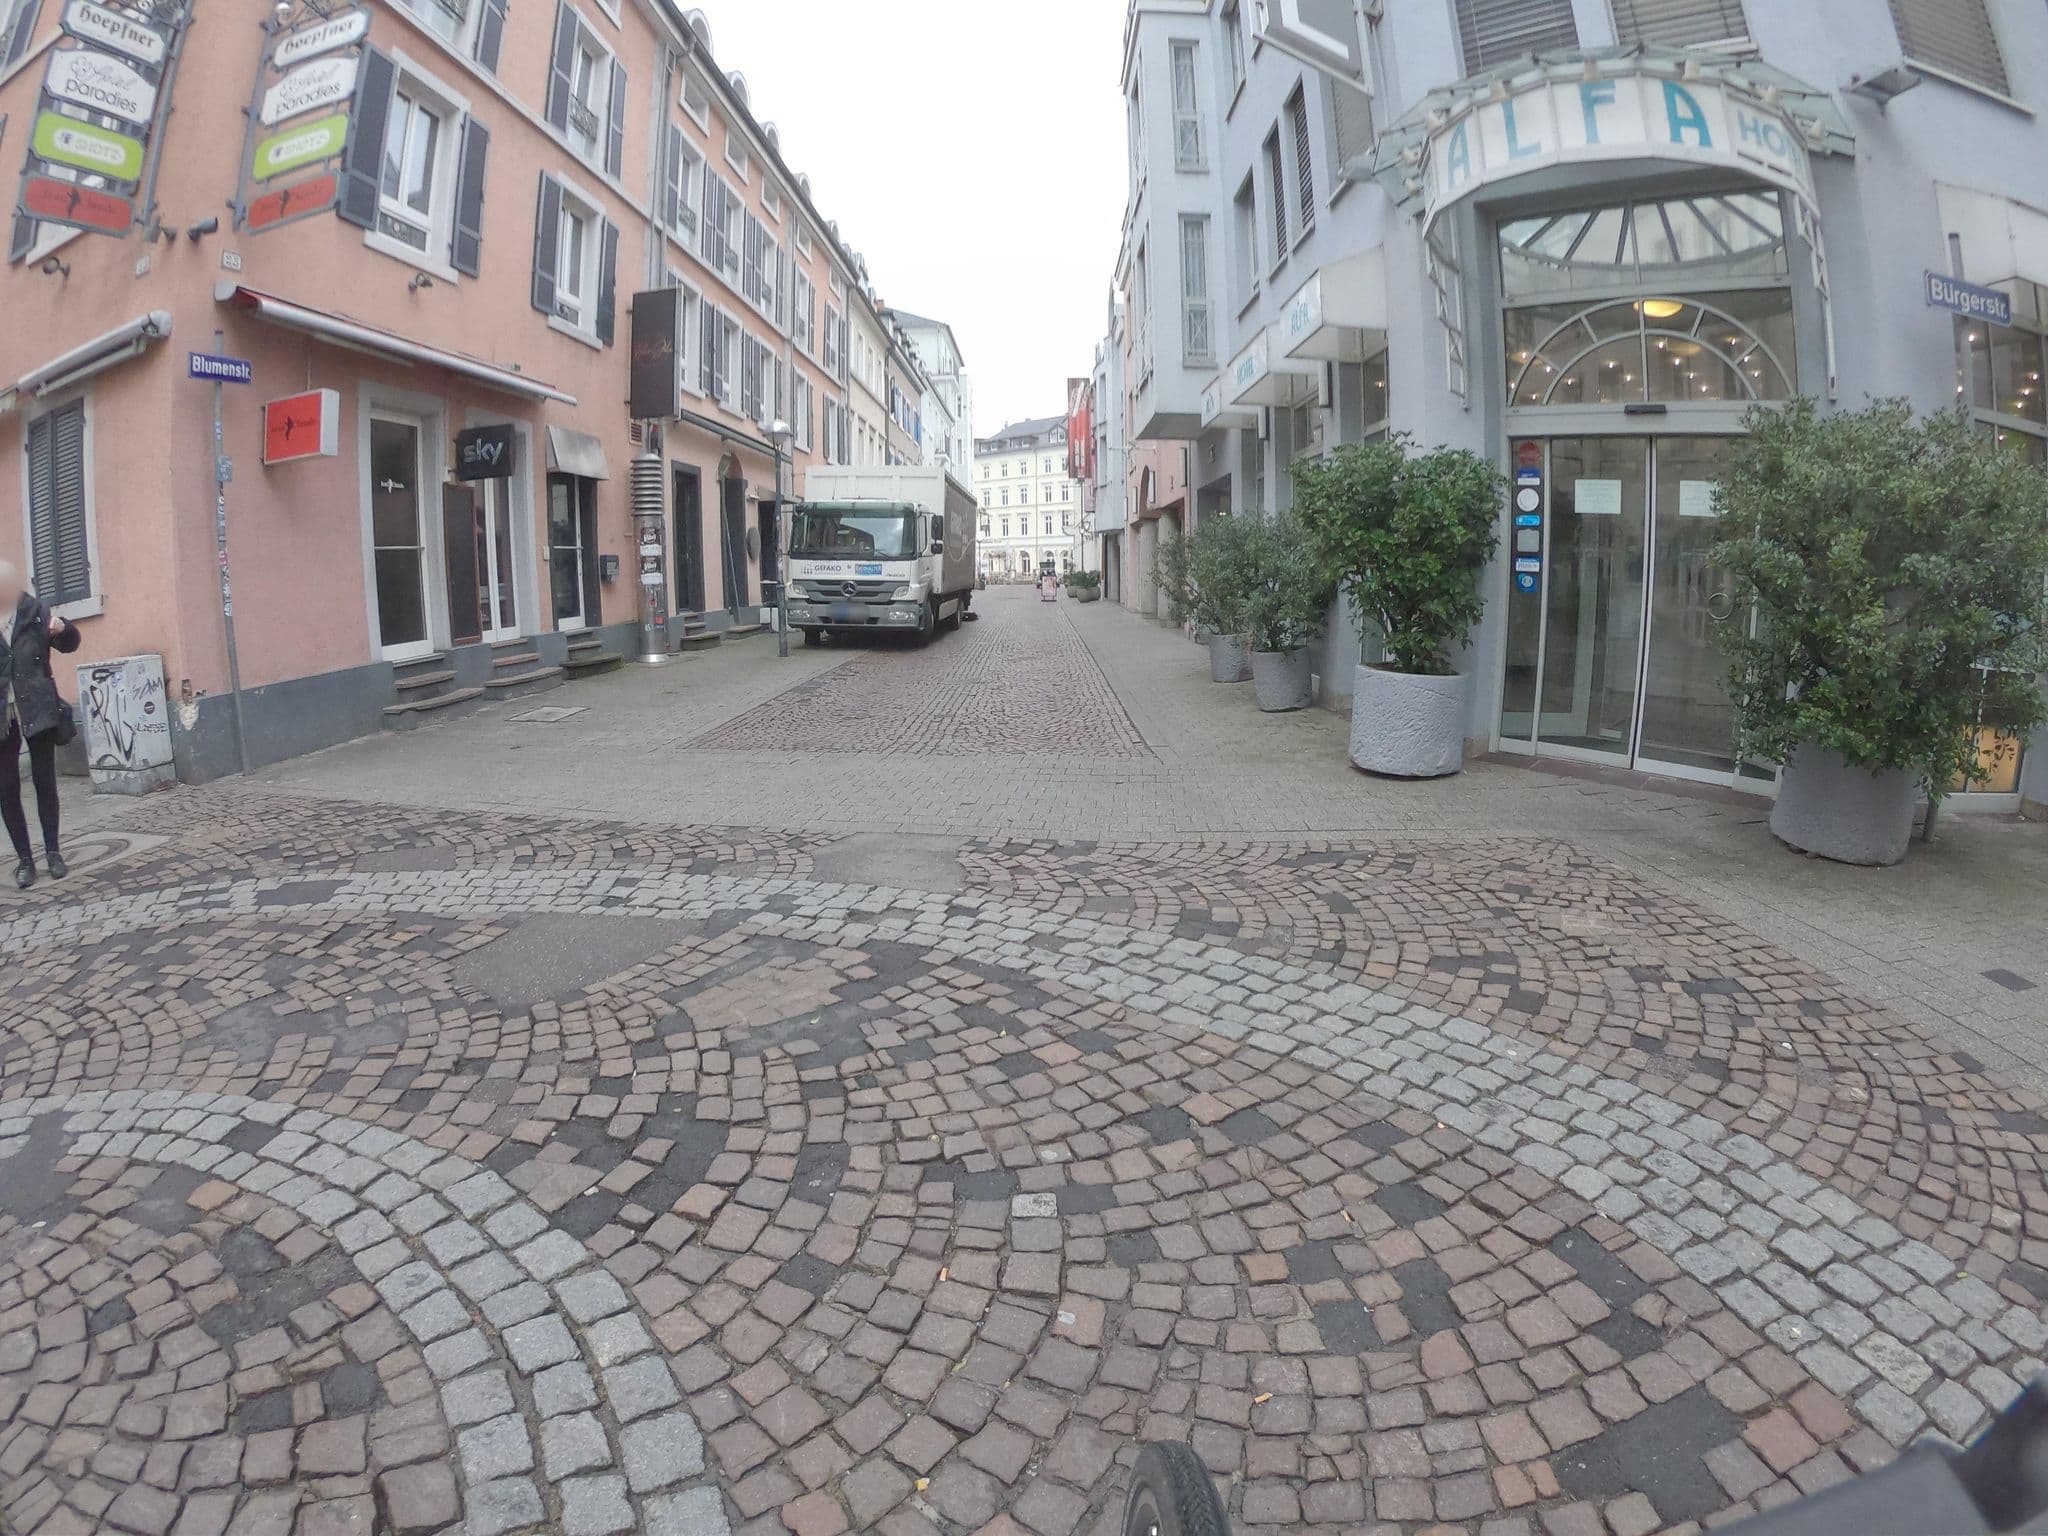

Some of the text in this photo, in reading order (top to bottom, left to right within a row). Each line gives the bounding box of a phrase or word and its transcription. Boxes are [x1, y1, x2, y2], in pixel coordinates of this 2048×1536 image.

[64, 78, 138, 113] paradies
[276, 82, 342, 115] paradies
[1447, 80, 1714, 190] ALFA
[1931, 278, 2009, 319] Bürgerstr.
[191, 354, 251, 380] Blumenstr.
[463, 438, 504, 465] sky
[814, 564, 842, 572] GEFAKO
